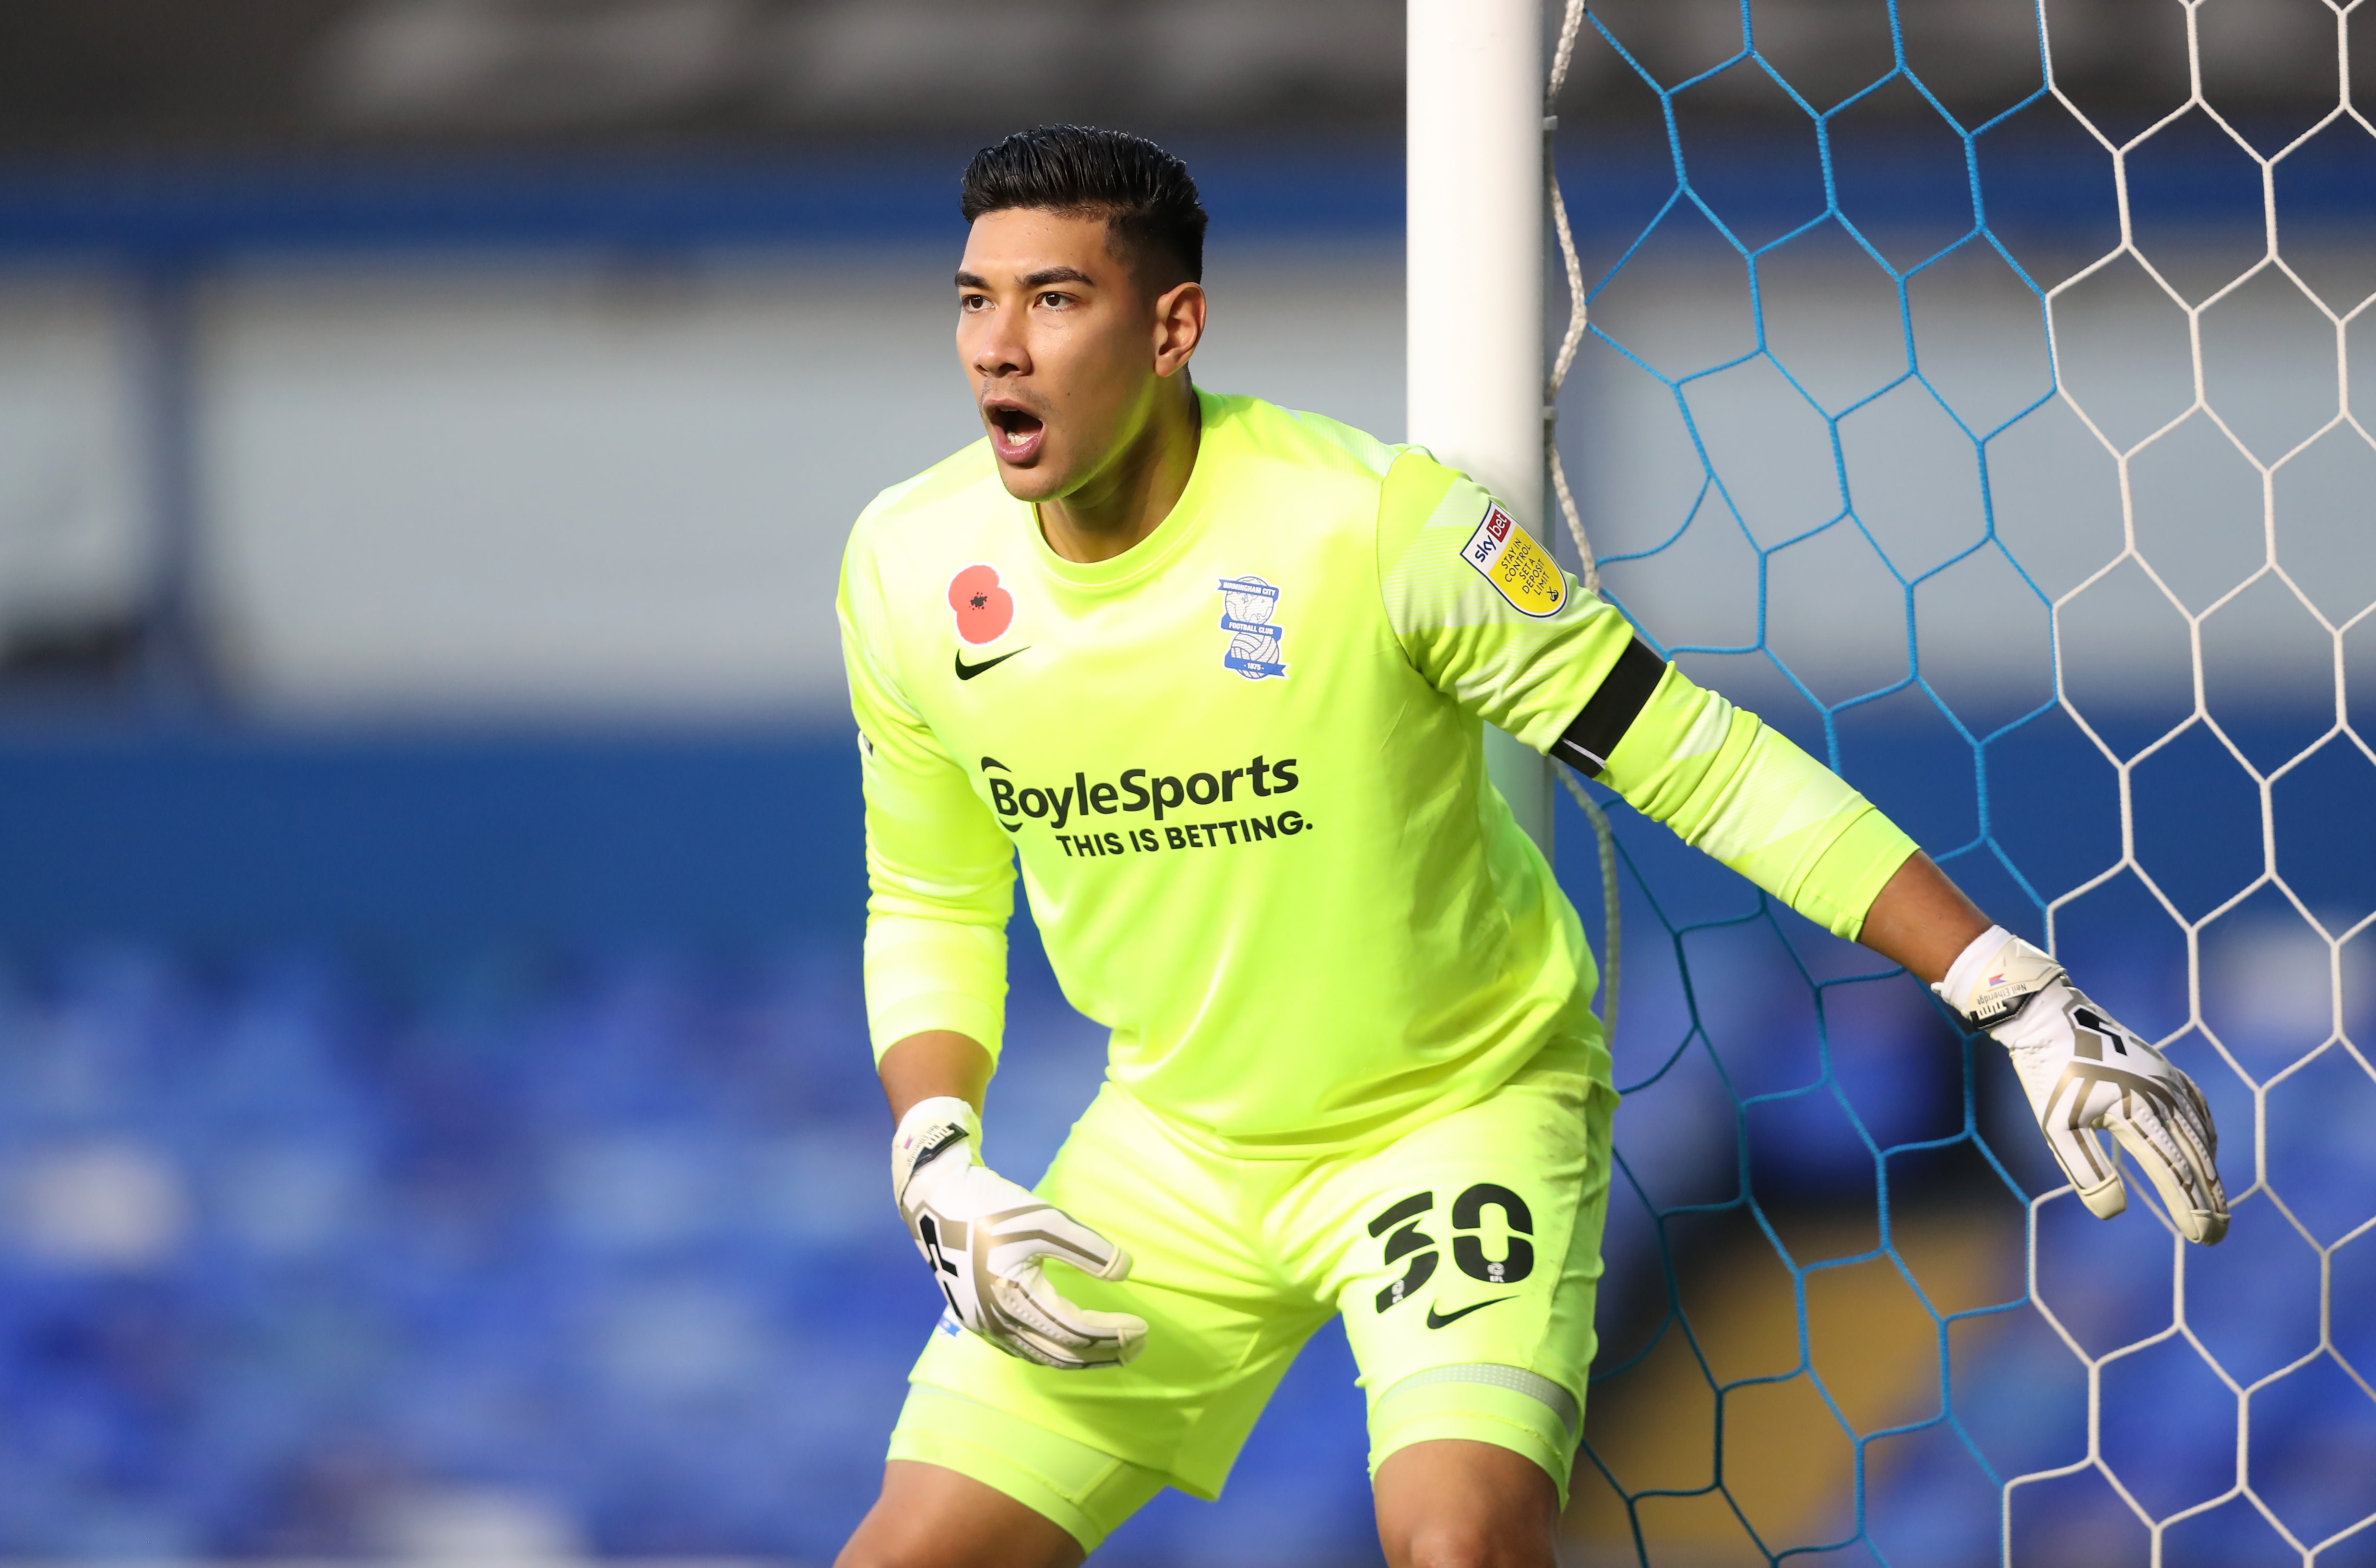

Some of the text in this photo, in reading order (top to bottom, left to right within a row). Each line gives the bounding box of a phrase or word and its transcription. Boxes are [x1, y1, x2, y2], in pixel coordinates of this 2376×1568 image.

[1475, 513, 1507, 562] sky bet
[1501, 537, 1522, 569] STAY IN
[1505, 544, 1532, 582] CONTROL.
[1519, 562, 1532, 580] SET
[1522, 558, 1544, 594] DEPOSIT
[1223, 582, 1275, 596] BIRMINGHAM CITY
[1533, 571, 1550, 595] LIMIT
[1229, 622, 1257, 632] FOOTBALL
[989, 755, 1299, 829] BoyleSports
[1055, 810, 1313, 857] THIS IS BETTING.
[1976, 983, 2027, 1005] Neil Etheridge
[1368, 1183, 1534, 1314] 30
